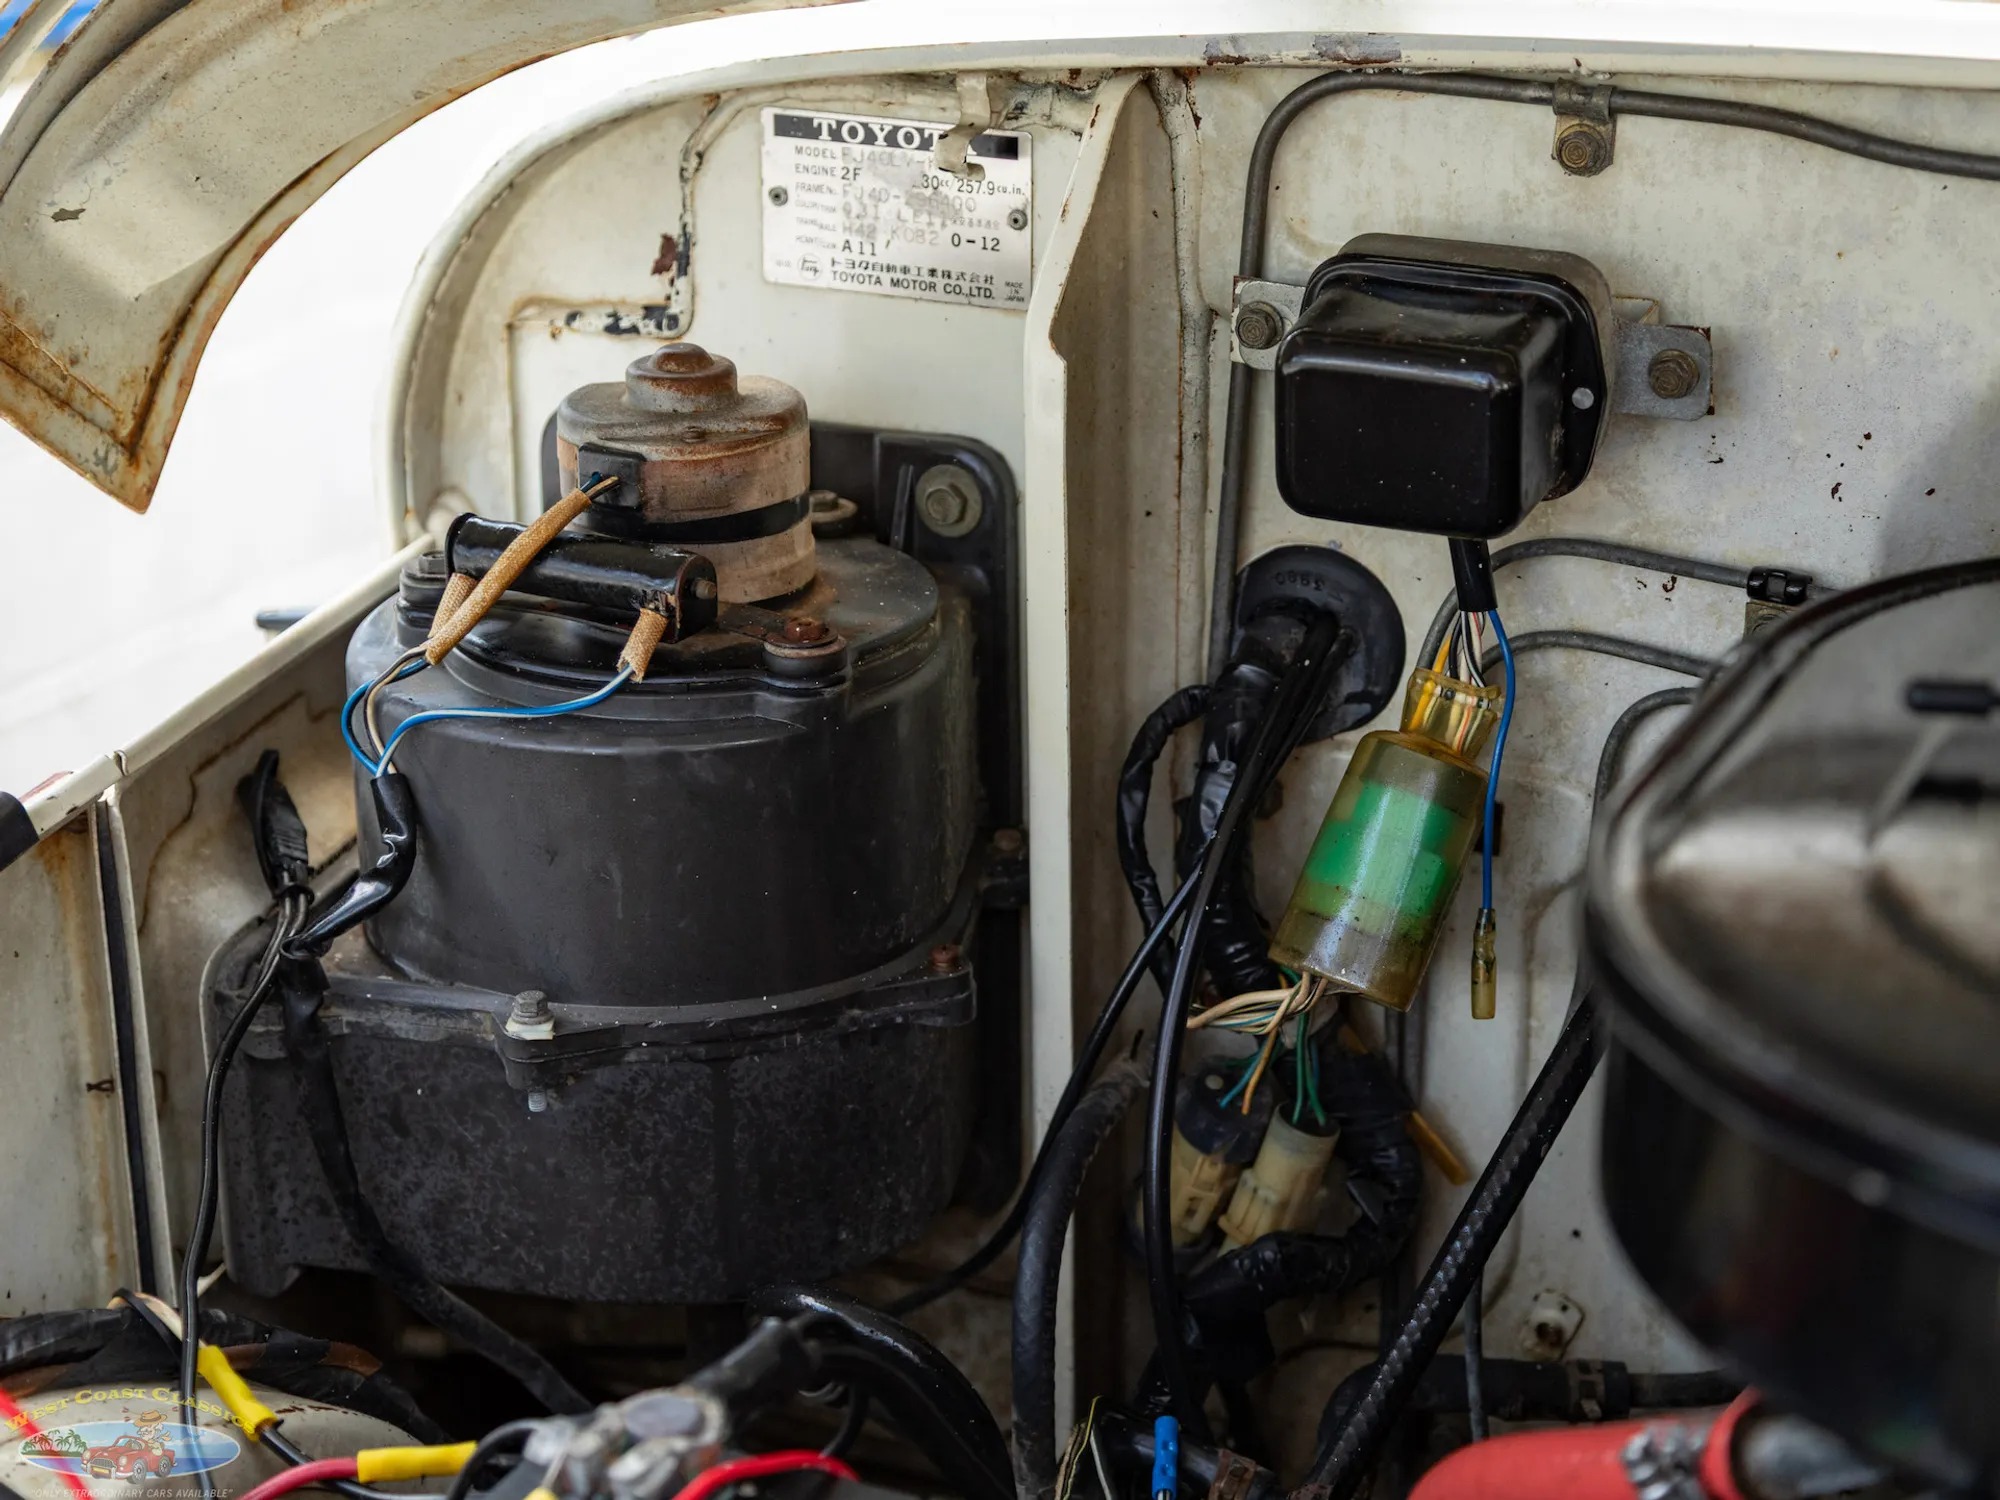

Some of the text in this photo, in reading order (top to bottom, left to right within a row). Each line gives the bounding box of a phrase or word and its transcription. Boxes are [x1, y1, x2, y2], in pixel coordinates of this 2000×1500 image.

[795, 162, 862, 181] ENGINE 2F
[832, 270, 882, 287] TOYOTA
[890, 276, 938, 293] MOTOR
